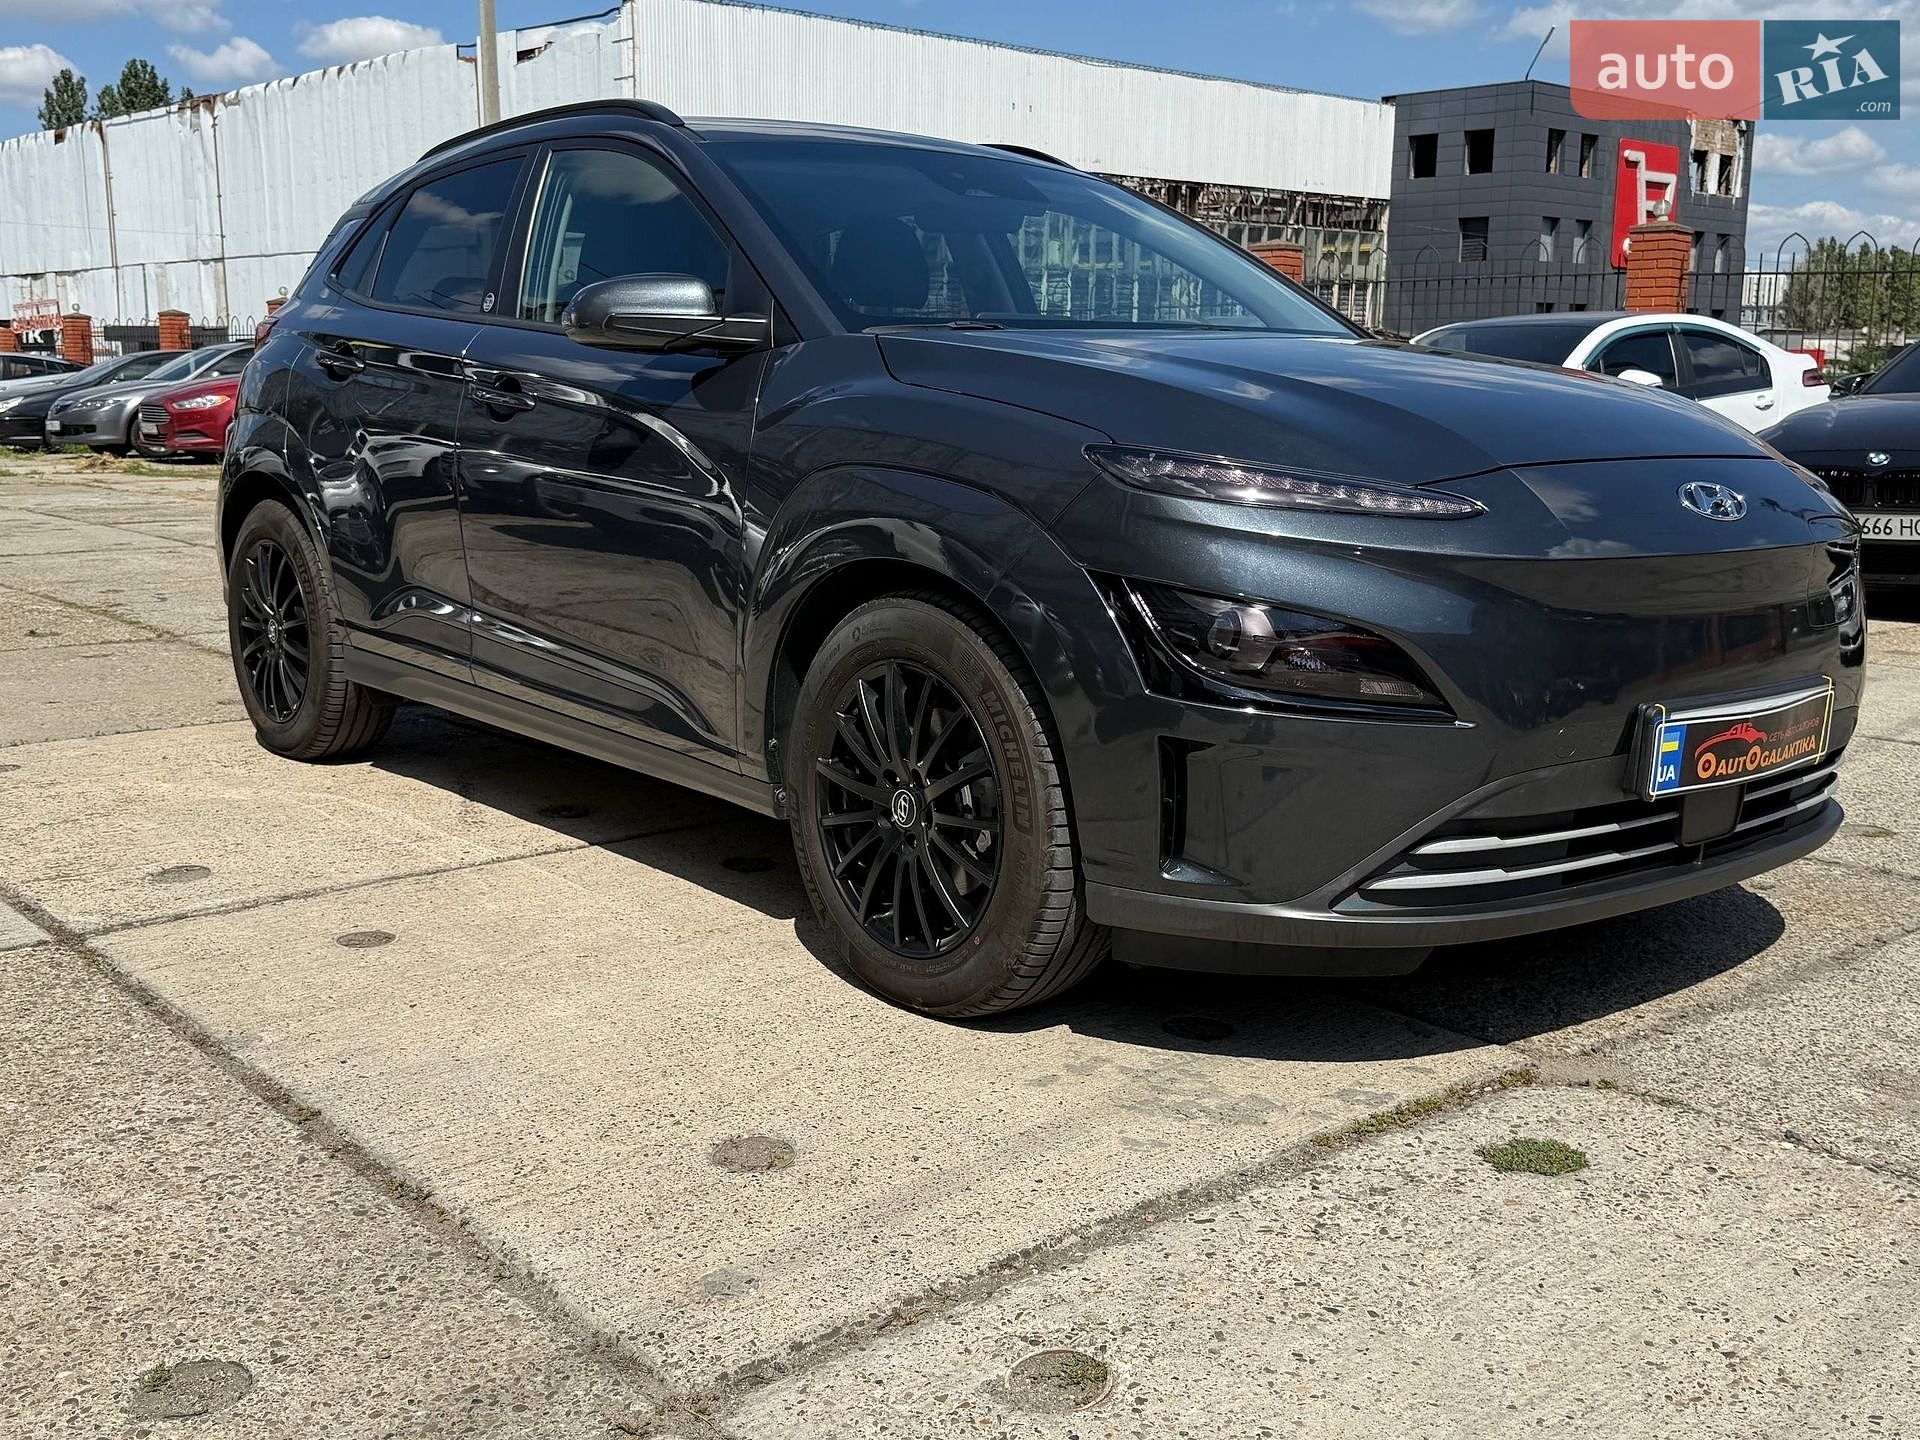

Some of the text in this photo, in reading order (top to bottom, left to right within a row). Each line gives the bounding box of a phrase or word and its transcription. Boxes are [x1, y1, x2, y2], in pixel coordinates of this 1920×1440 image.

[1857, 518, 1893, 535] 666
[982, 690, 1032, 829] MICHELIN
[1657, 765, 1676, 783] UA
